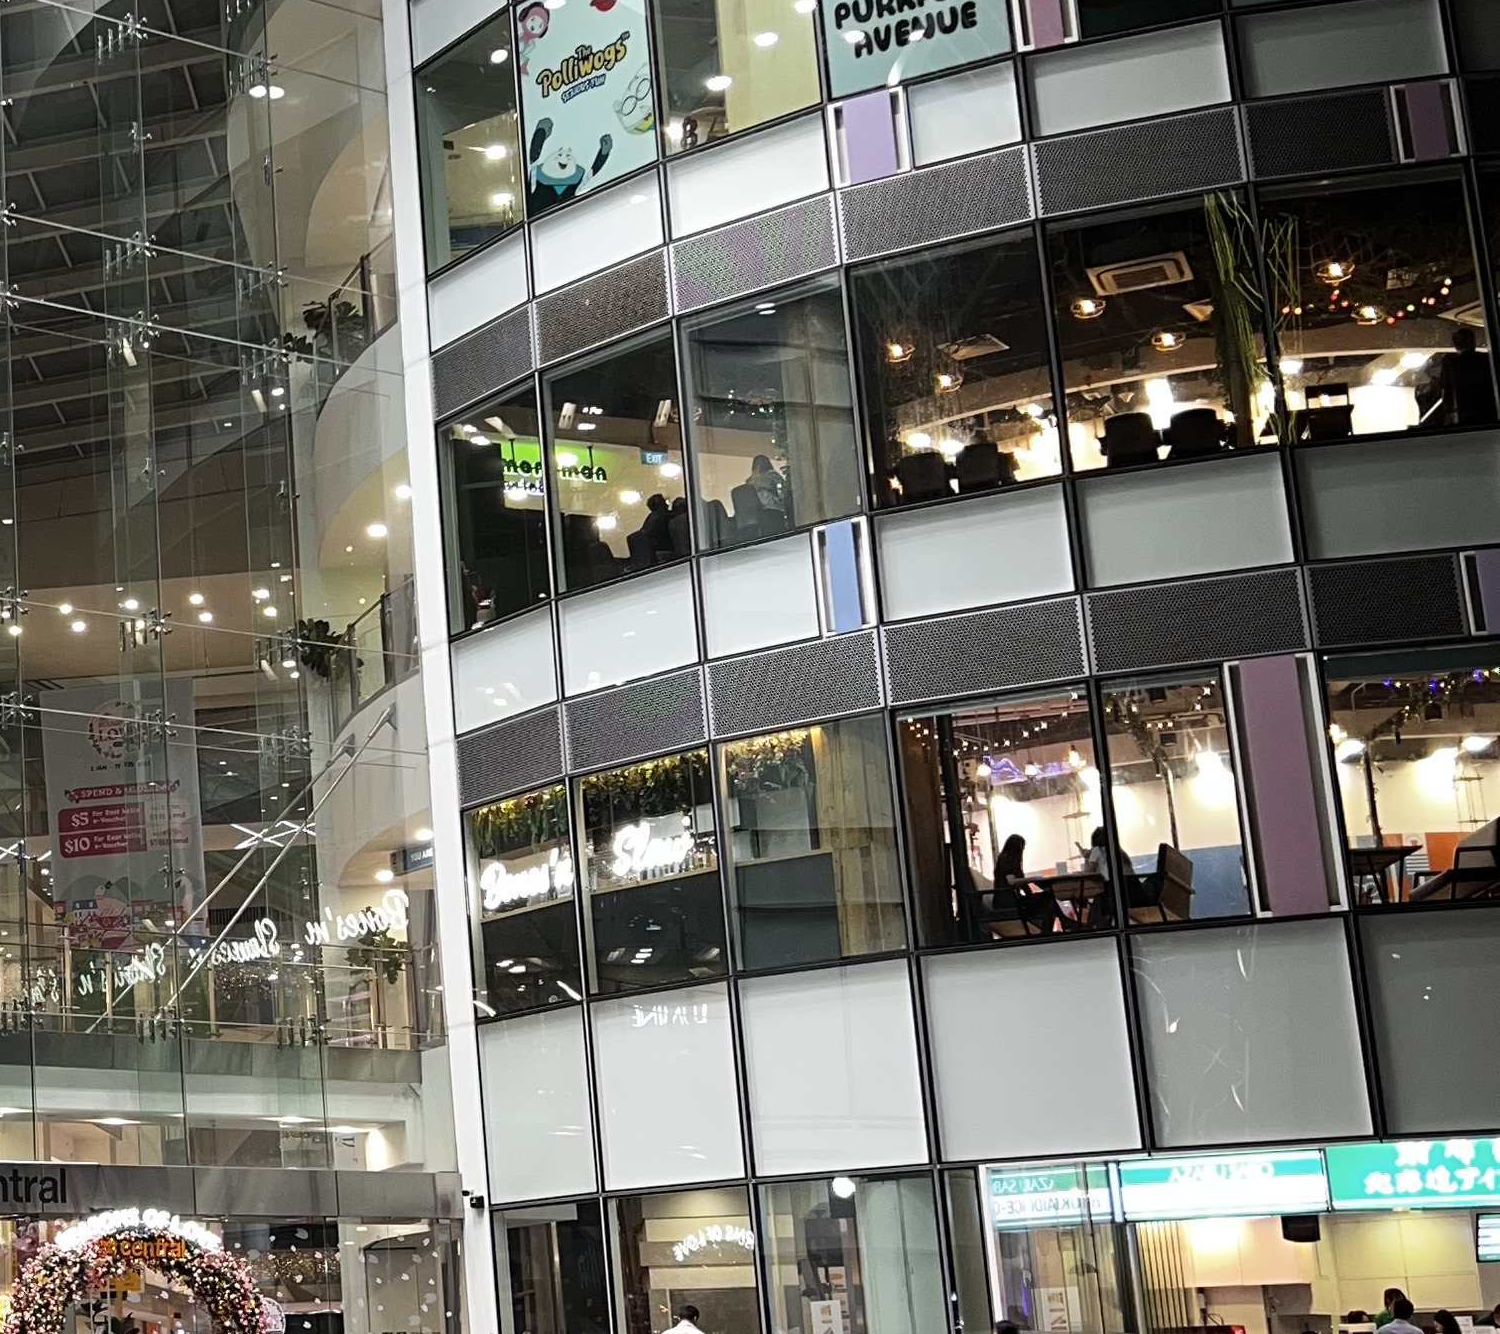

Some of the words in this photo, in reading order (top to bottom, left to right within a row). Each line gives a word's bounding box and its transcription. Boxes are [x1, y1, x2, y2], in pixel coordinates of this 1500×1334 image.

[854, 1, 977, 59] AVENUE
[536, 39, 627, 98] Polliwogs
[646, 454, 662, 463] EXIT
[80, 788, 113, 798] SPEND
[115, 788, 122, 796] &
[71, 811, 89, 828] $5
[64, 836, 90, 854] $10
[120, 1238, 187, 1258] central
